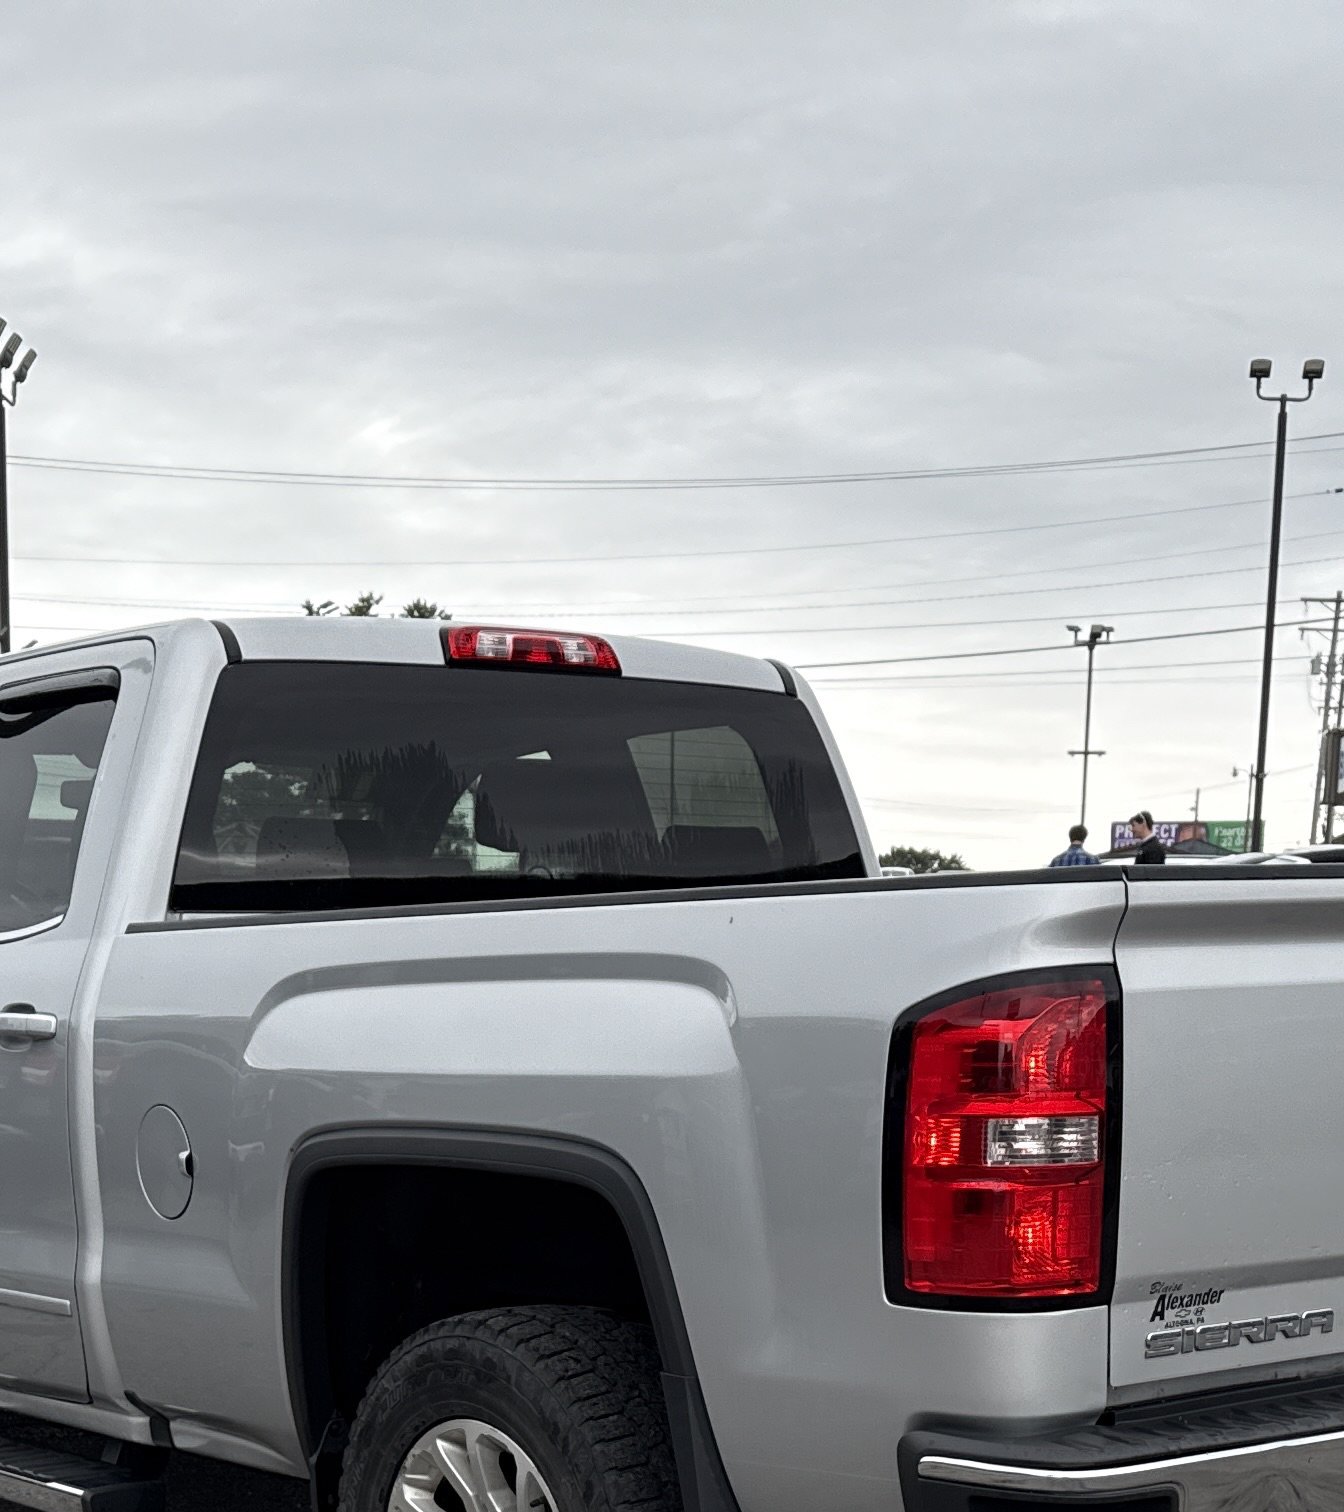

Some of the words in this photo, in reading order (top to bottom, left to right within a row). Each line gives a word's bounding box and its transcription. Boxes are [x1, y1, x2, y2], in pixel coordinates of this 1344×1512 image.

[1149, 1281, 1184, 1295] Blaise
[1149, 1287, 1225, 1322] Alexander
[1144, 1308, 1335, 1359] SIERRA
